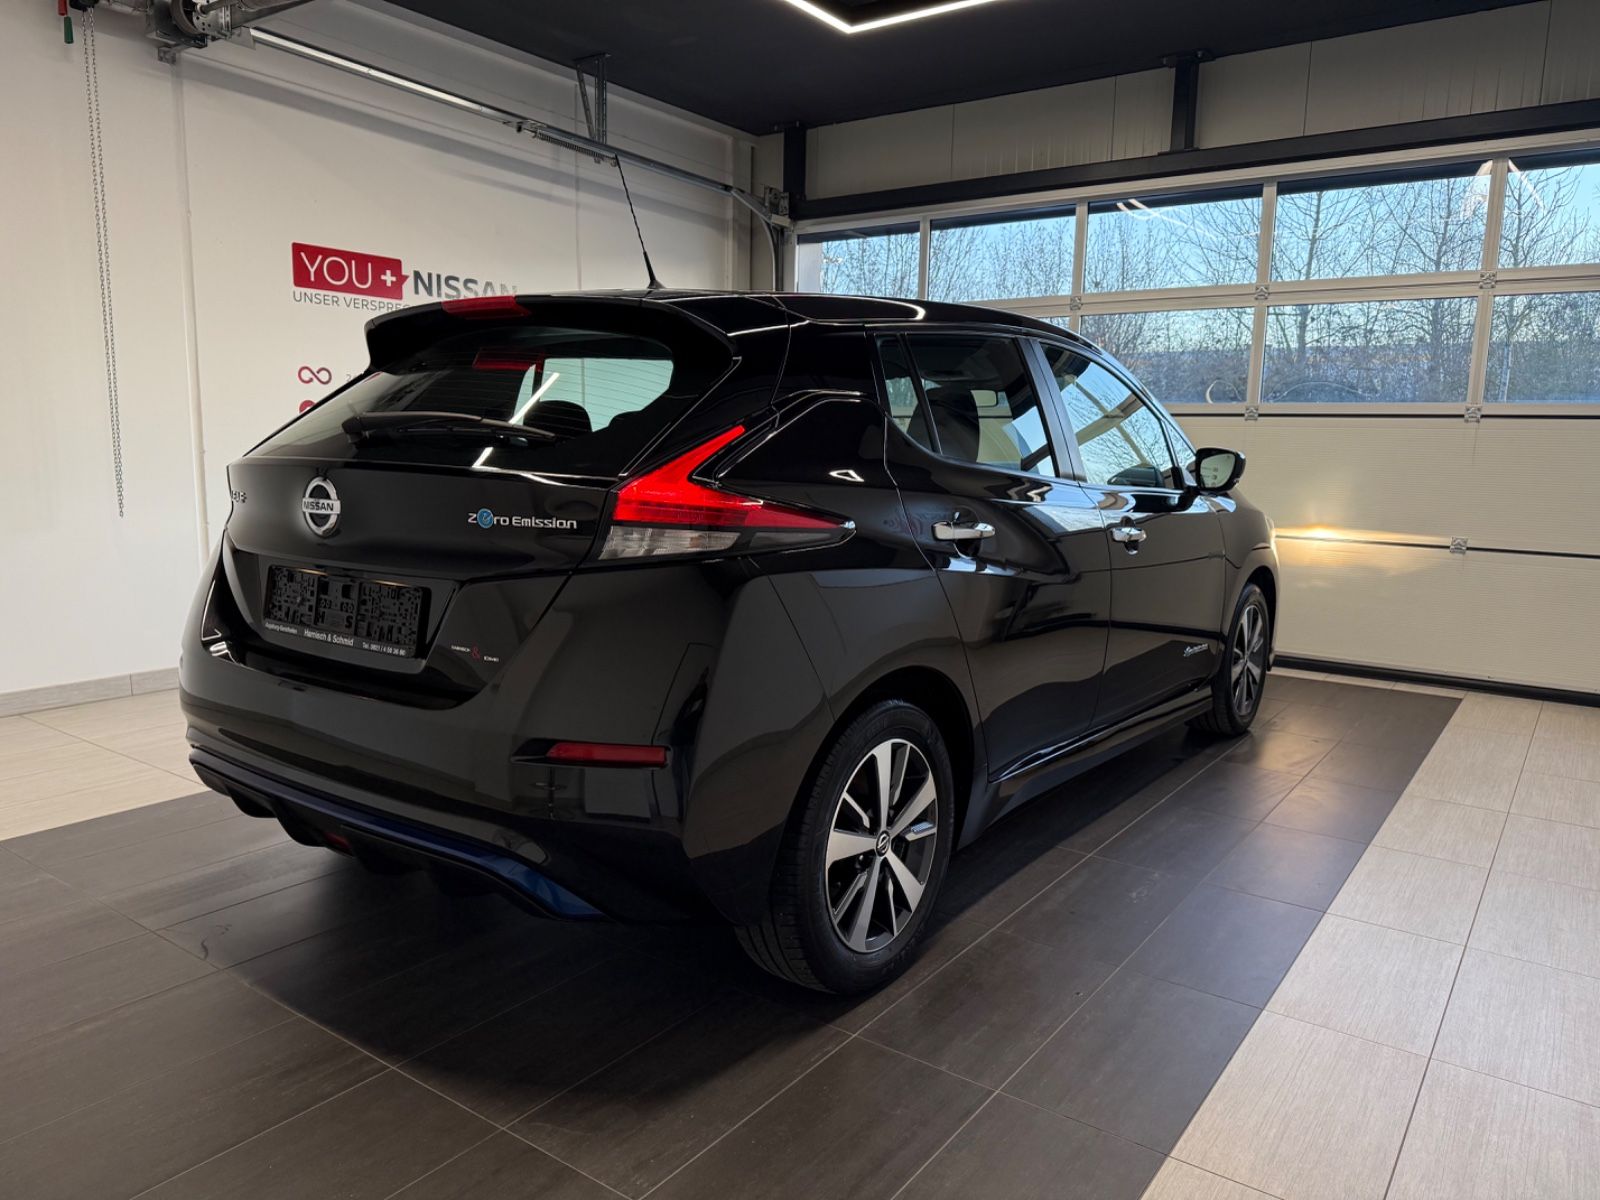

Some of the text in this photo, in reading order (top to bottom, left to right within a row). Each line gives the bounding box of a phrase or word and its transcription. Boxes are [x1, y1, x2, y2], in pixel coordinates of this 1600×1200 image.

[300, 251, 372, 289] YOU
[293, 291, 410, 312] UNSER VERSPRE
[303, 500, 334, 512] NISSAN
[511, 515, 578, 529] Emission
